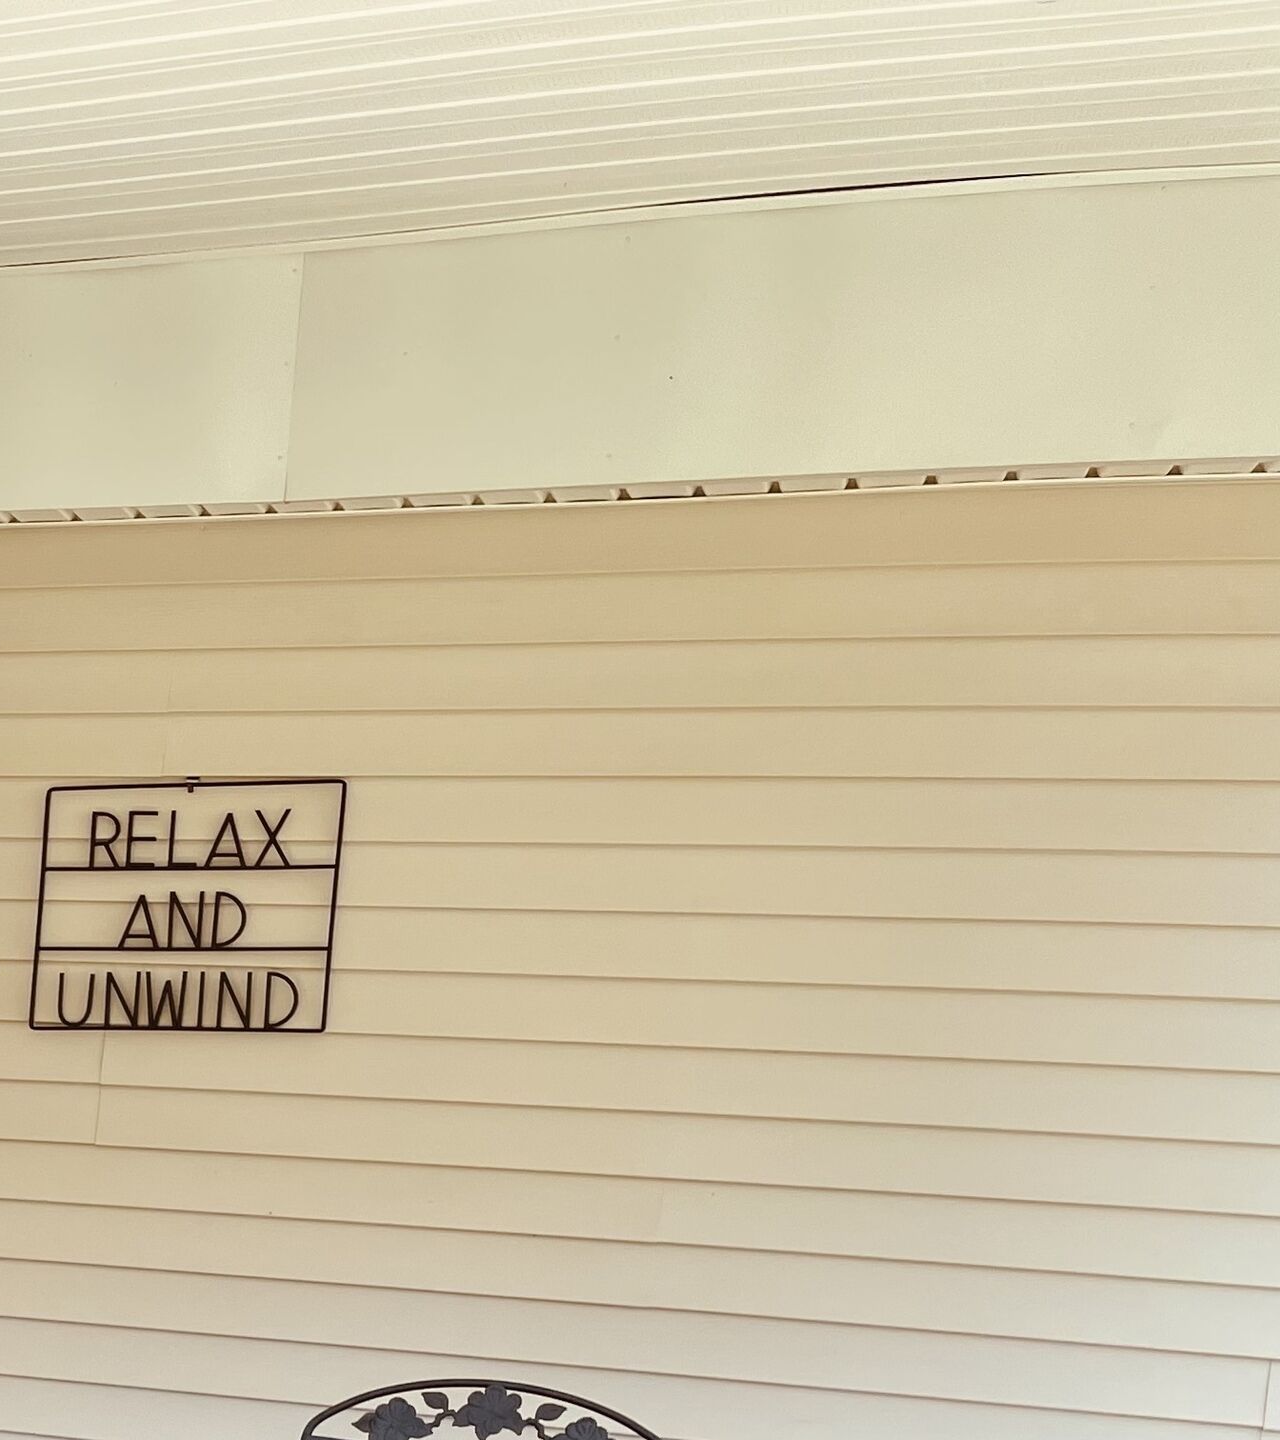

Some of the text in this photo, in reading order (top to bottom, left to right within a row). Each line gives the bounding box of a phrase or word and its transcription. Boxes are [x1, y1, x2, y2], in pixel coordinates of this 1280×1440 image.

[89, 808, 292, 868] RELAX
[117, 890, 248, 949] AND
[57, 970, 300, 1029] UNWIND
